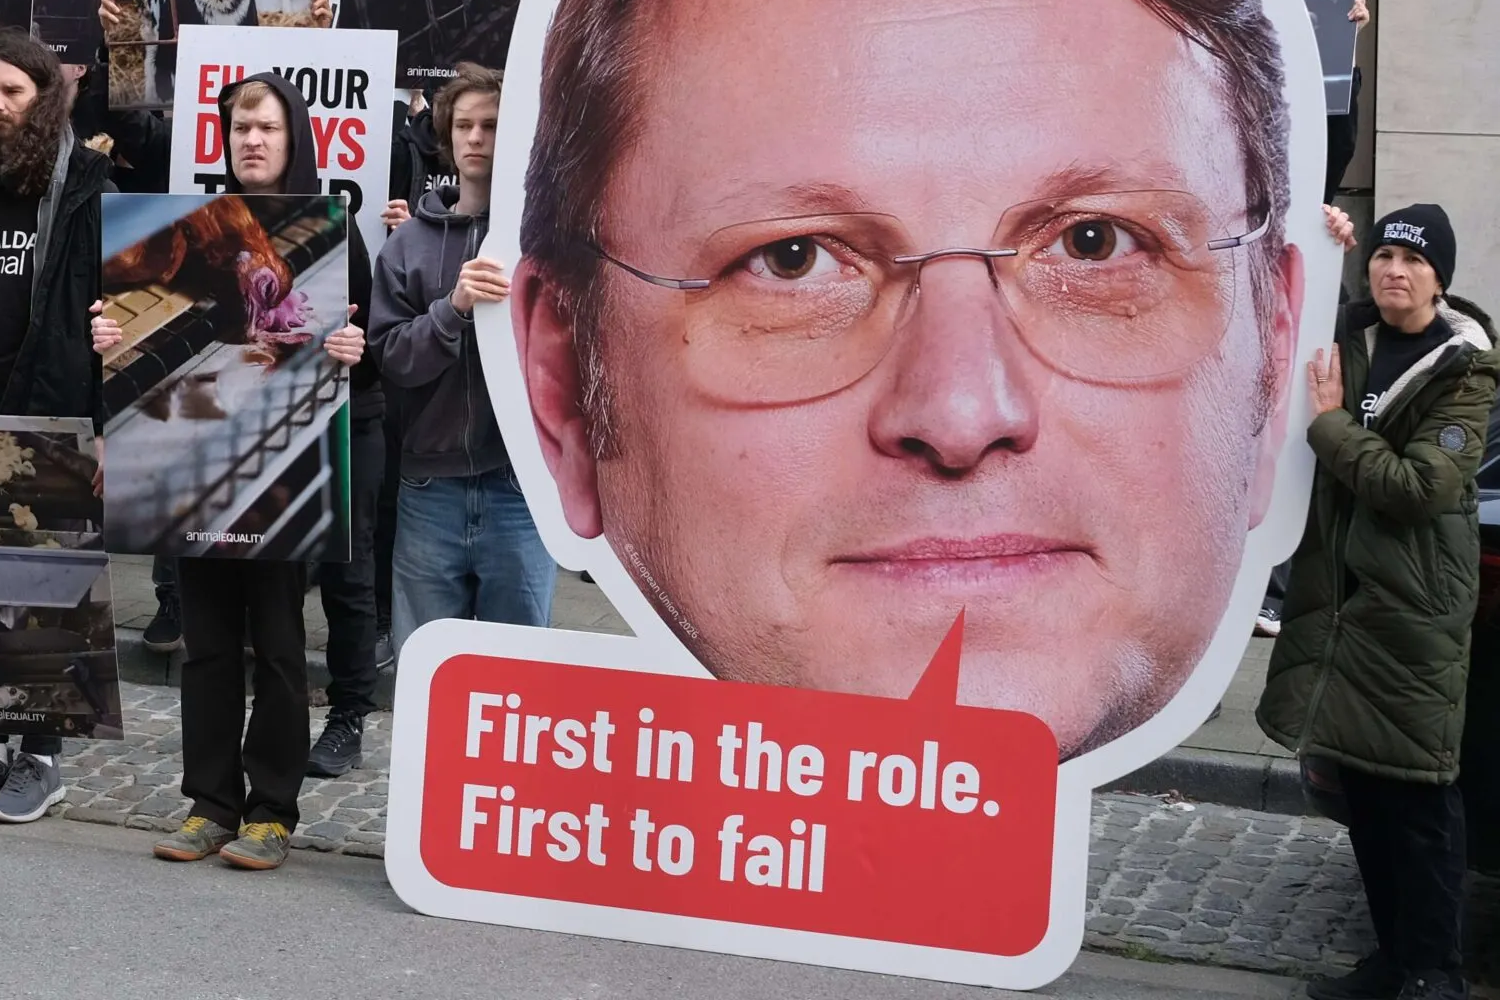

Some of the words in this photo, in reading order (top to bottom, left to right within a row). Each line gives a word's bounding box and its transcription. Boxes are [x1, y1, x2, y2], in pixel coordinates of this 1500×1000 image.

[407, 65, 460, 78] animalEQUA
[1384, 230, 1429, 248] EQUALITY
[186, 529, 266, 543] animalEQUALITY
[630, 551, 660, 593] European
[658, 591, 679, 621] Union,
[678, 618, 698, 639] 2026
[464, 691, 616, 774] First
[636, 707, 694, 783] in
[717, 721, 826, 797] the
[847, 740, 1001, 818] role.
[459, 783, 609, 867] First
[629, 808, 695, 876] to
[718, 814, 828, 893] fail
